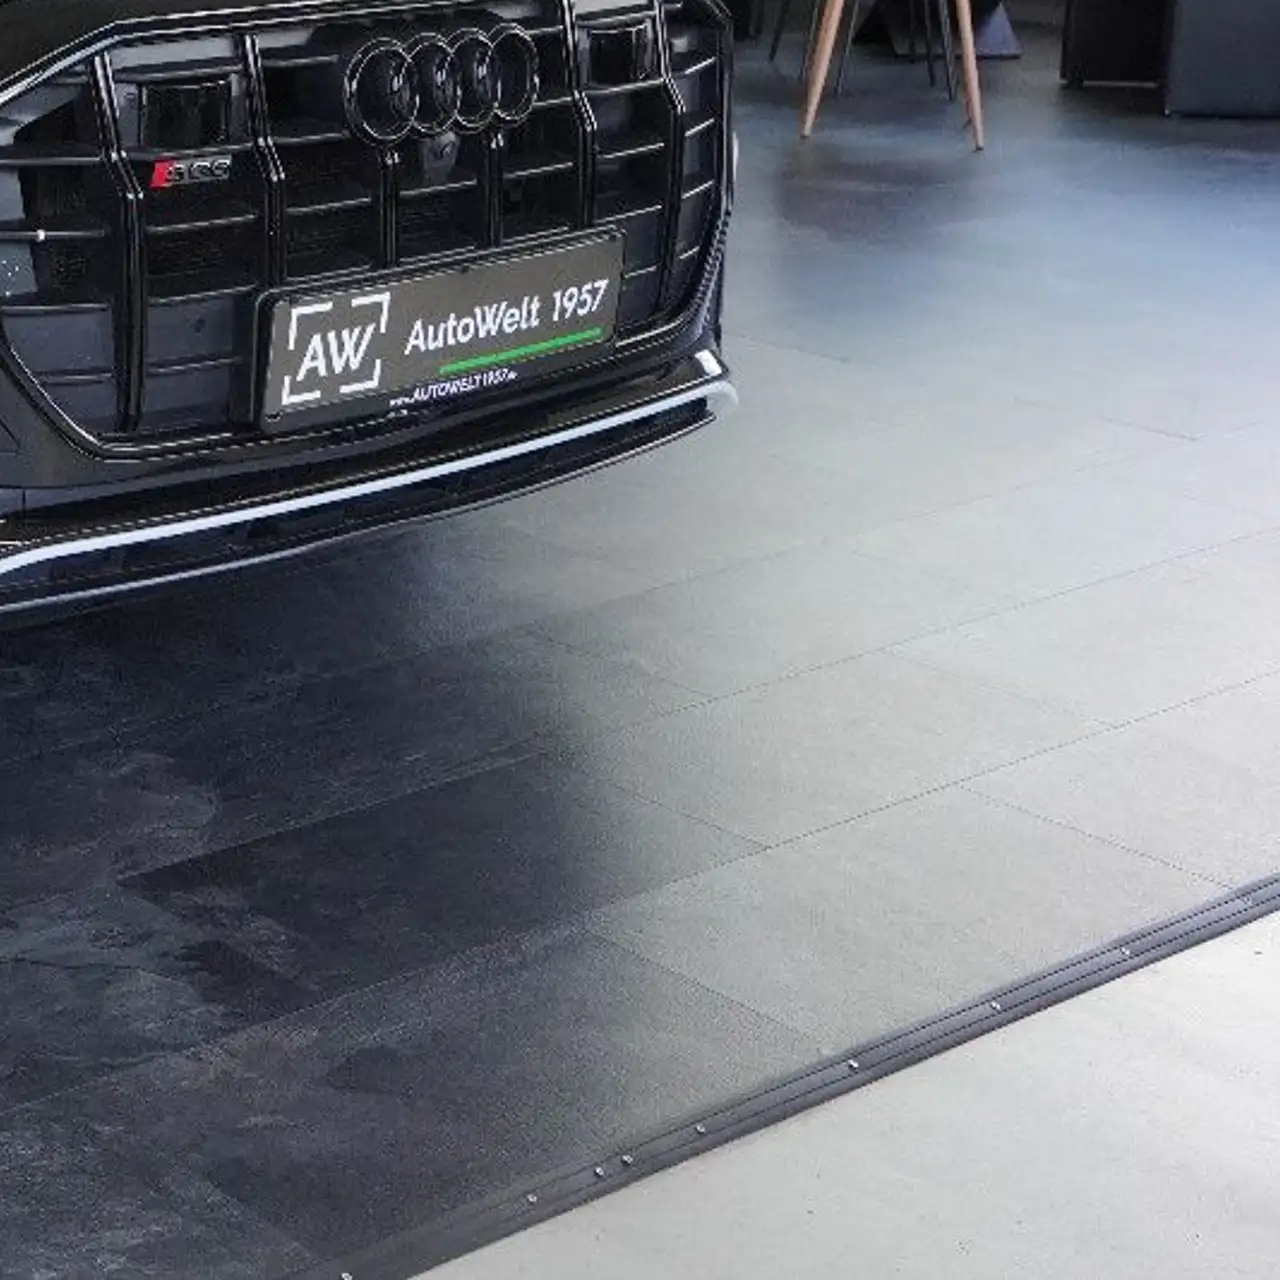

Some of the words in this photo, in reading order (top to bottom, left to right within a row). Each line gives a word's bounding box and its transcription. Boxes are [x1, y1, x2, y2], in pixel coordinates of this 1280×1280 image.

[404, 297, 540, 355] AutoWelt
[550, 279, 609, 320] 1957
[296, 323, 375, 382] AW
